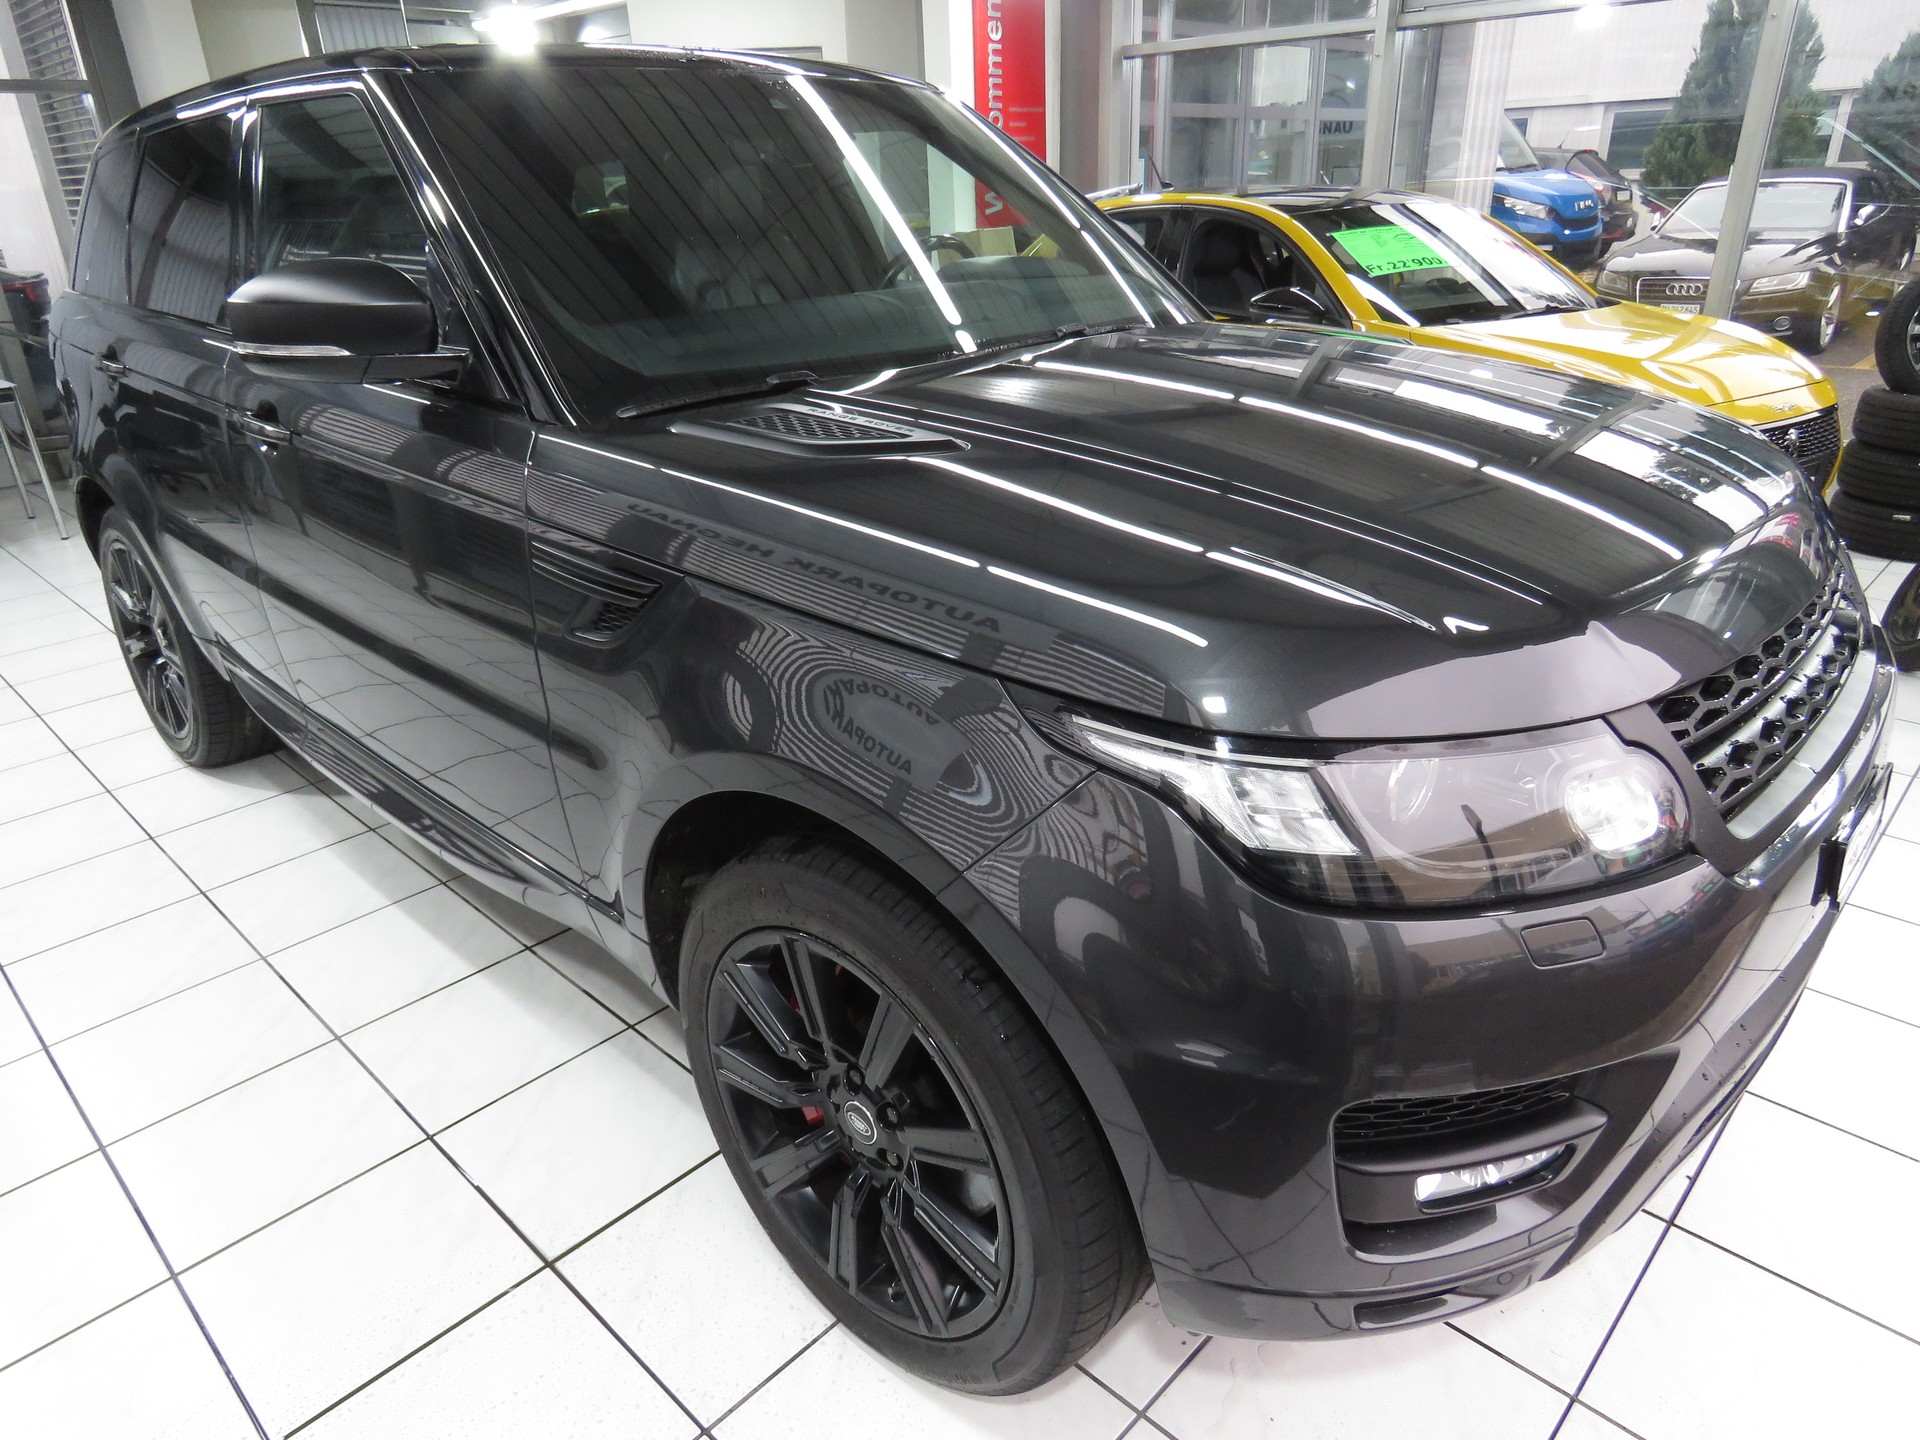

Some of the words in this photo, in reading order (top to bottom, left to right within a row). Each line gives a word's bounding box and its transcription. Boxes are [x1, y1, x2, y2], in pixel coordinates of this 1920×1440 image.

[1319, 120, 1353, 135] NAU
[807, 408, 858, 421] RANGE
[863, 419, 916, 433] ROVER
